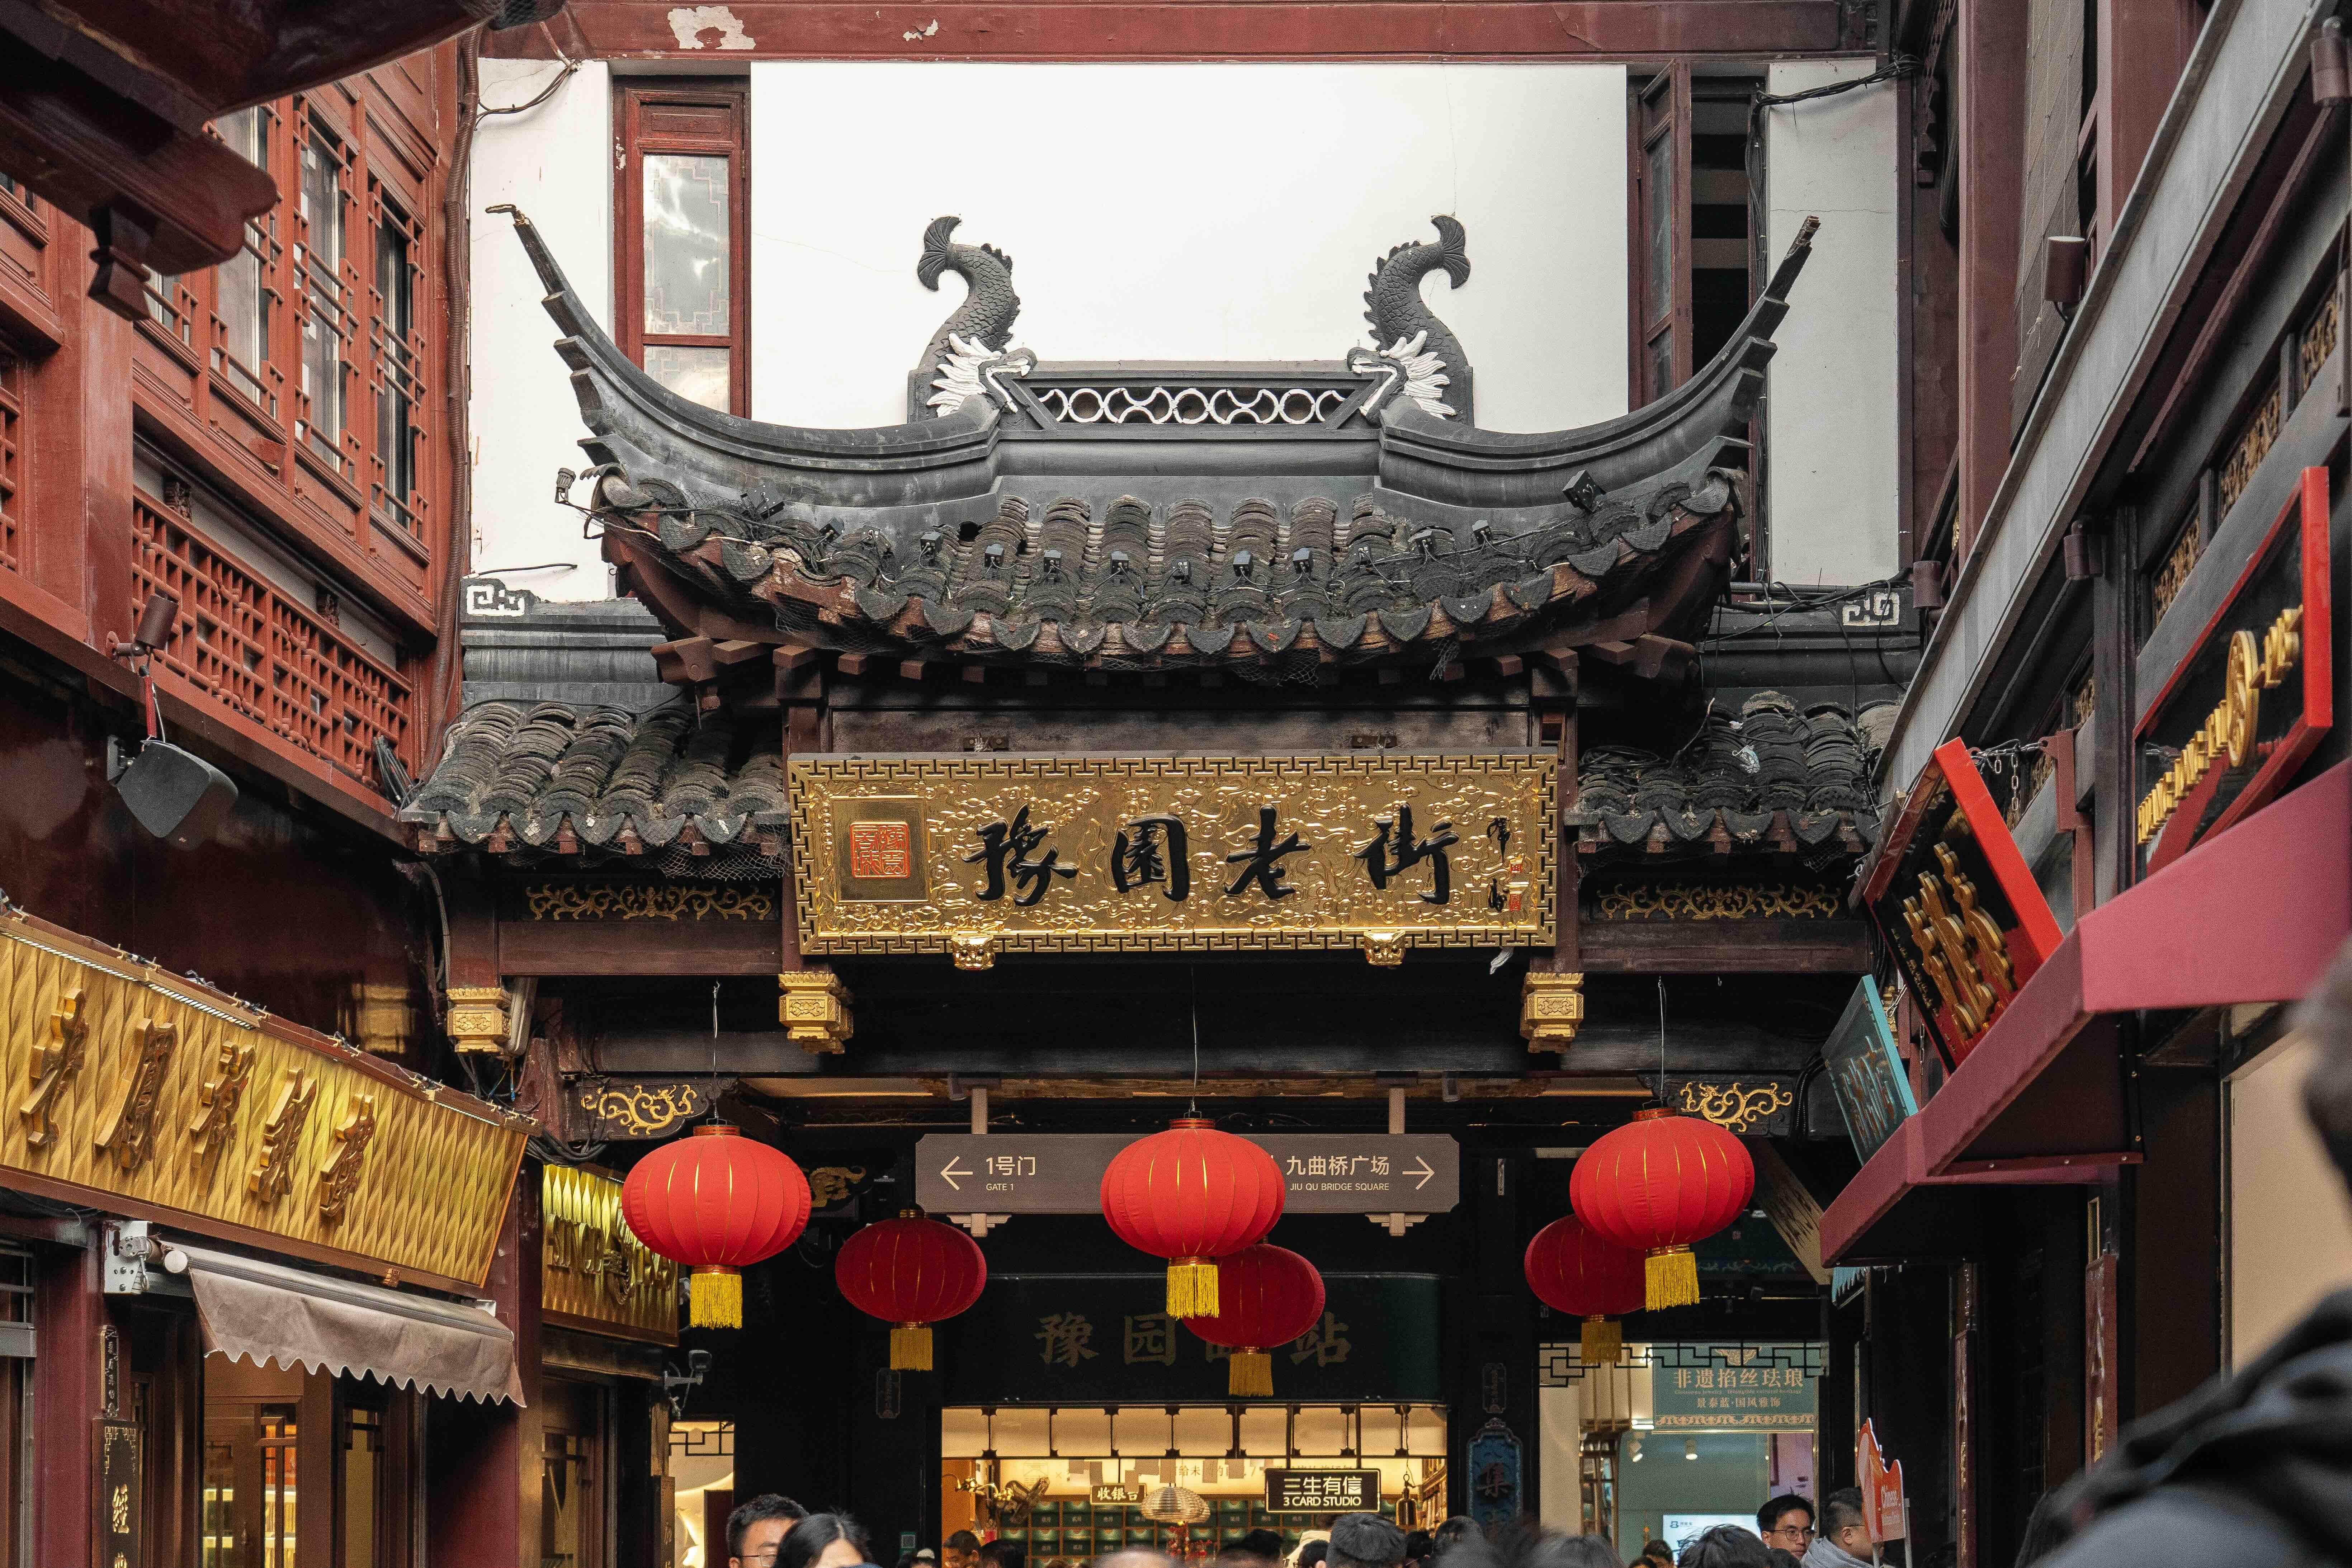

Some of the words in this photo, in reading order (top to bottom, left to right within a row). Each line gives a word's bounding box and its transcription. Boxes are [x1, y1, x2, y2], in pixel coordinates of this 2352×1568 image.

[962, 802, 1459, 906] 豫園老街
[986, 1156, 1036, 1176] 1号门
[1286, 1155, 1389, 1176] 九曲桥广场
[1305, 1183, 1318, 1191] QU
[1034, 1311, 1352, 1368] 豫园站
[1673, 1368, 1804, 1388] 非遗掐丝珐琅
[1283, 1476, 1362, 1495] 三生有信
[1283, 1497, 1290, 1506] 3
[1292, 1497, 1321, 1506] CARD
[1323, 1497, 1361, 1506] STUDIO
